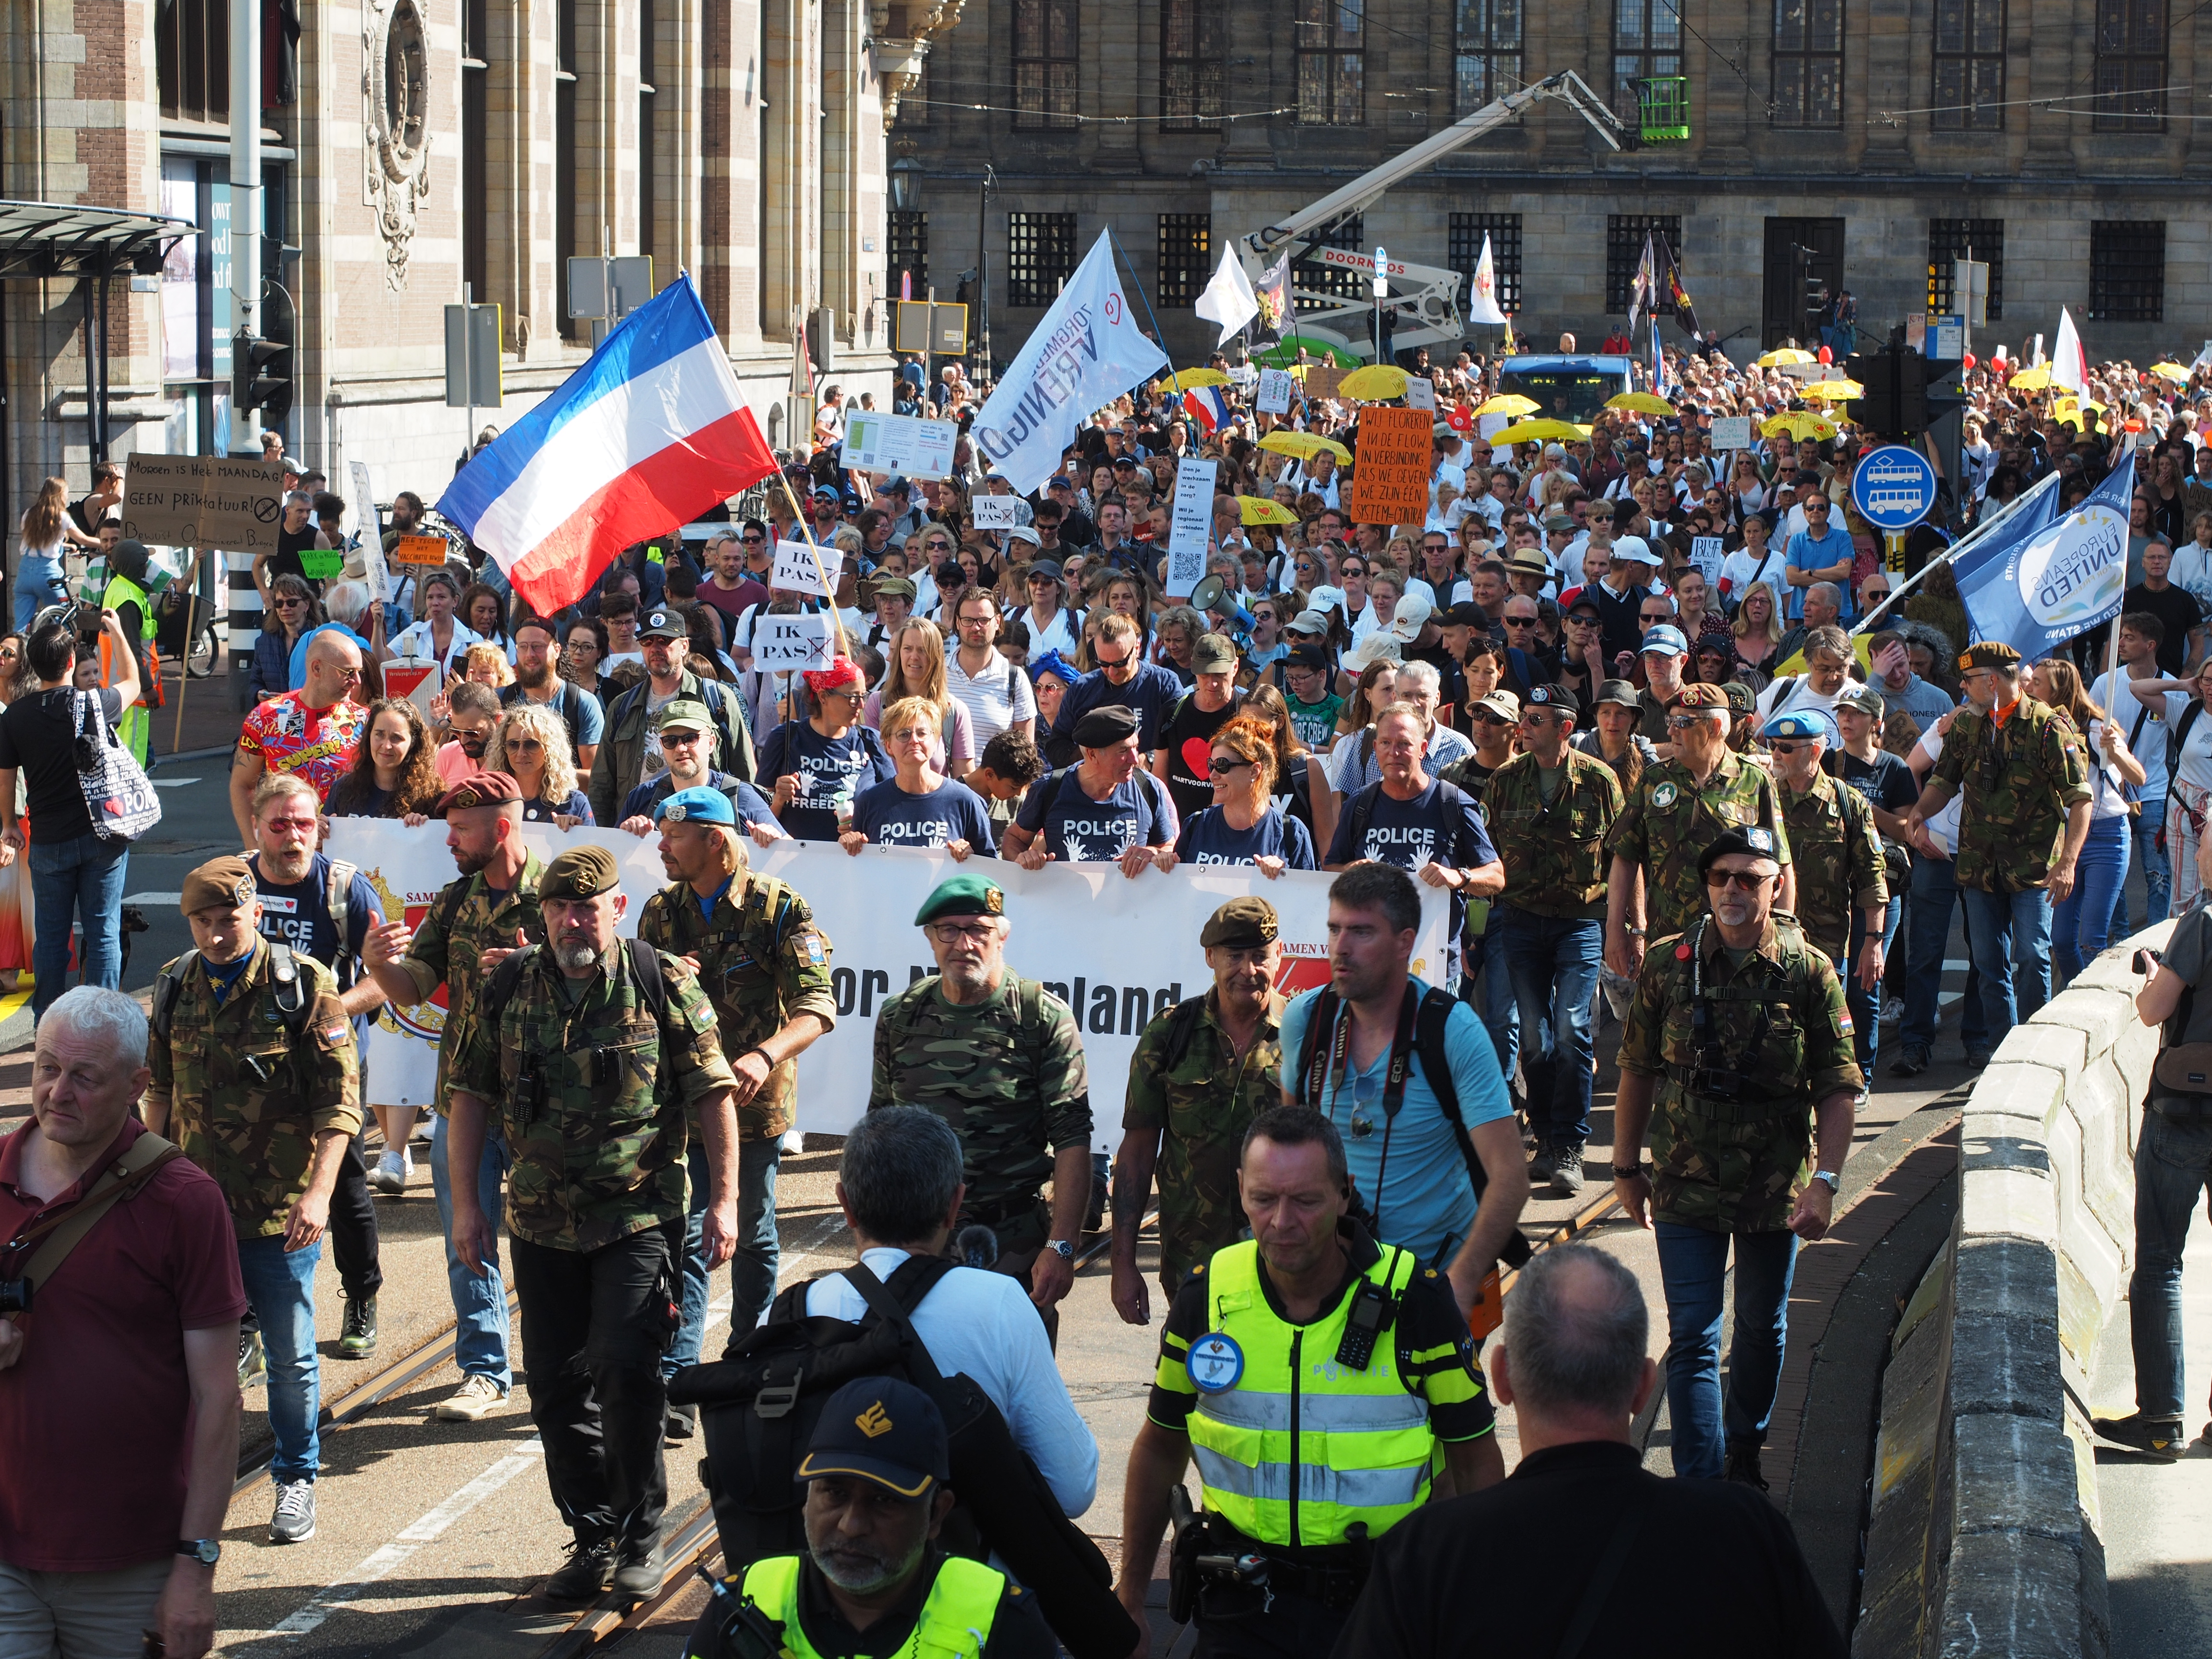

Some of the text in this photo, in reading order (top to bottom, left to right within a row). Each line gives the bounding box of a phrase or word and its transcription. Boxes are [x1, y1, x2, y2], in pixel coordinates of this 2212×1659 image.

[1326, 251, 1405, 274] DOORNOS
[1366, 410, 1431, 430] WIJ FLOREREN
[1368, 433, 1378, 446] IN
[1381, 433, 1392, 447] DE
[1361, 449, 1371, 464] IN
[192, 464, 212, 477] Het
[218, 467, 285, 483] MAANDAG!
[1358, 468, 1429, 485] ALS WE GEVEN:
[130, 493, 163, 505] GEEN
[1360, 485, 1421, 502] WE ZIJN ÉÉN
[301, 552, 317, 561] MARK
[399, 553, 428, 562] VACCINATIE
[792, 552, 814, 565] IK
[779, 566, 816, 583] PAS
[775, 626, 802, 638] IK
[762, 646, 807, 659] PAS
[1308, 721, 1329, 743] CREW
[277, 740, 341, 771] SUPER!
[800, 756, 862, 773] POLICE
[792, 797, 838, 810] FREED
[879, 821, 948, 838] POLICE
[1063, 819, 1138, 835] POLICE
[1365, 827, 1436, 845] POLICE
[1196, 851, 1256, 866] POLIC
[1282, 943, 1317, 955] AMEN
[1336, 1016, 1349, 1058] Canon
[1311, 1050, 1327, 1093] Canon
[1391, 1056, 1404, 1083] EOS
